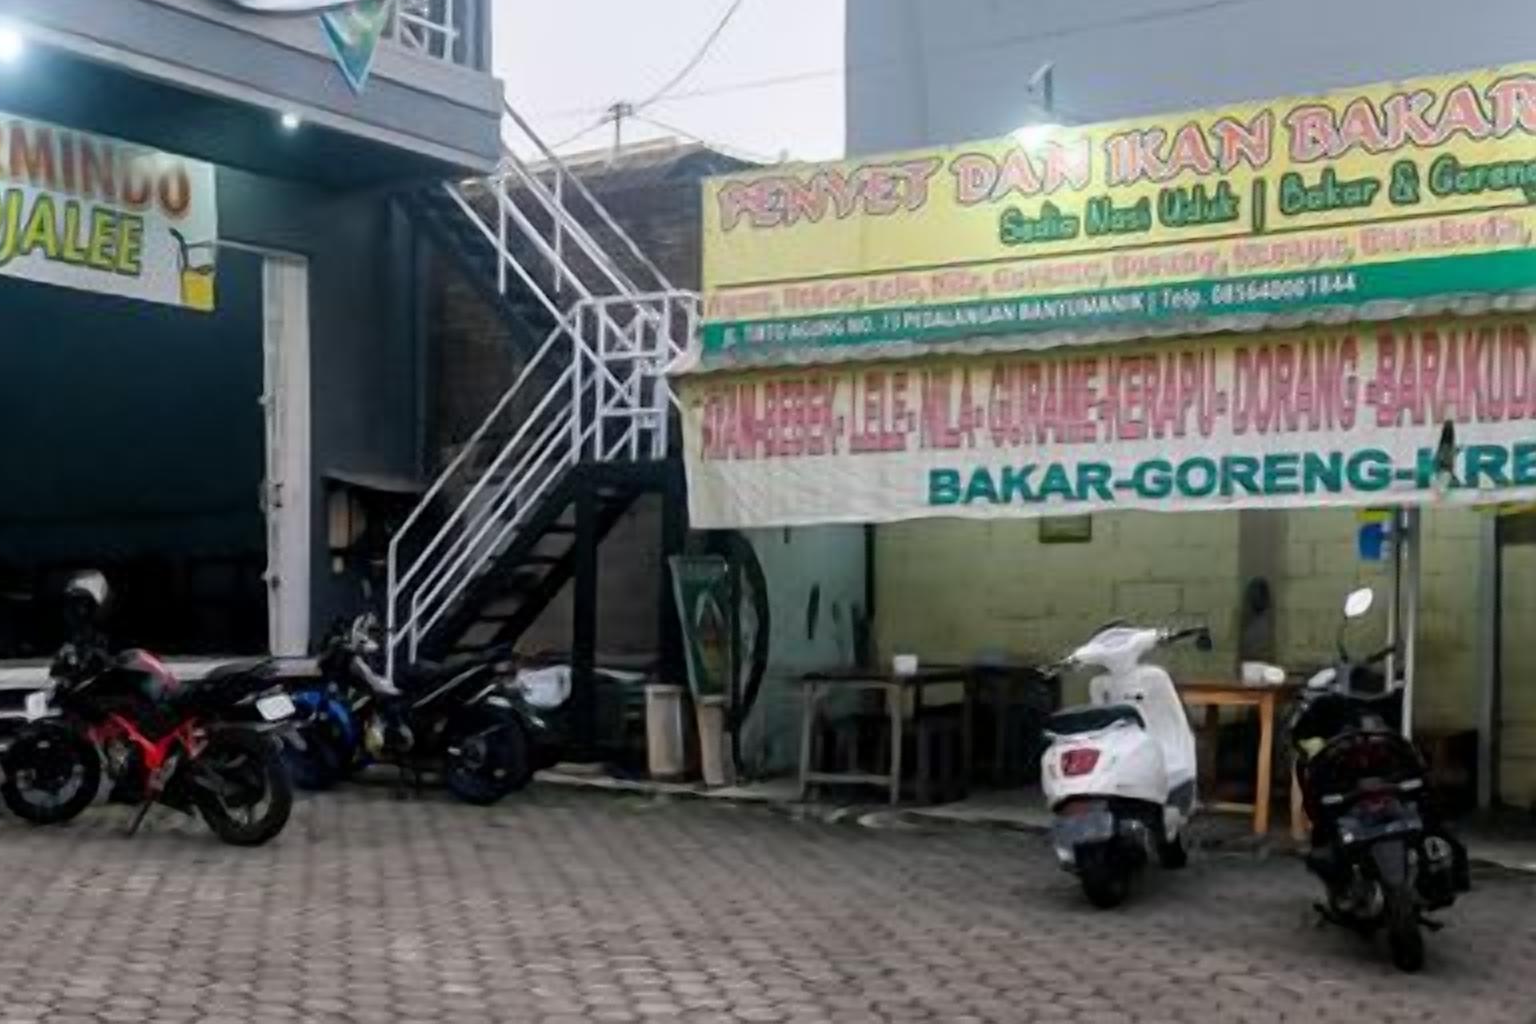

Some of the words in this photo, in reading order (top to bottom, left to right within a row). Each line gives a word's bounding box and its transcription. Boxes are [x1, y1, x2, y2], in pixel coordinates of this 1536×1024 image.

[718, 157, 943, 231] PENYET
[950, 136, 1090, 207] DAN
[1105, 109, 1276, 186] IKAN
[1279, 167, 1381, 216] Bakar
[1389, 160, 1420, 205] &
